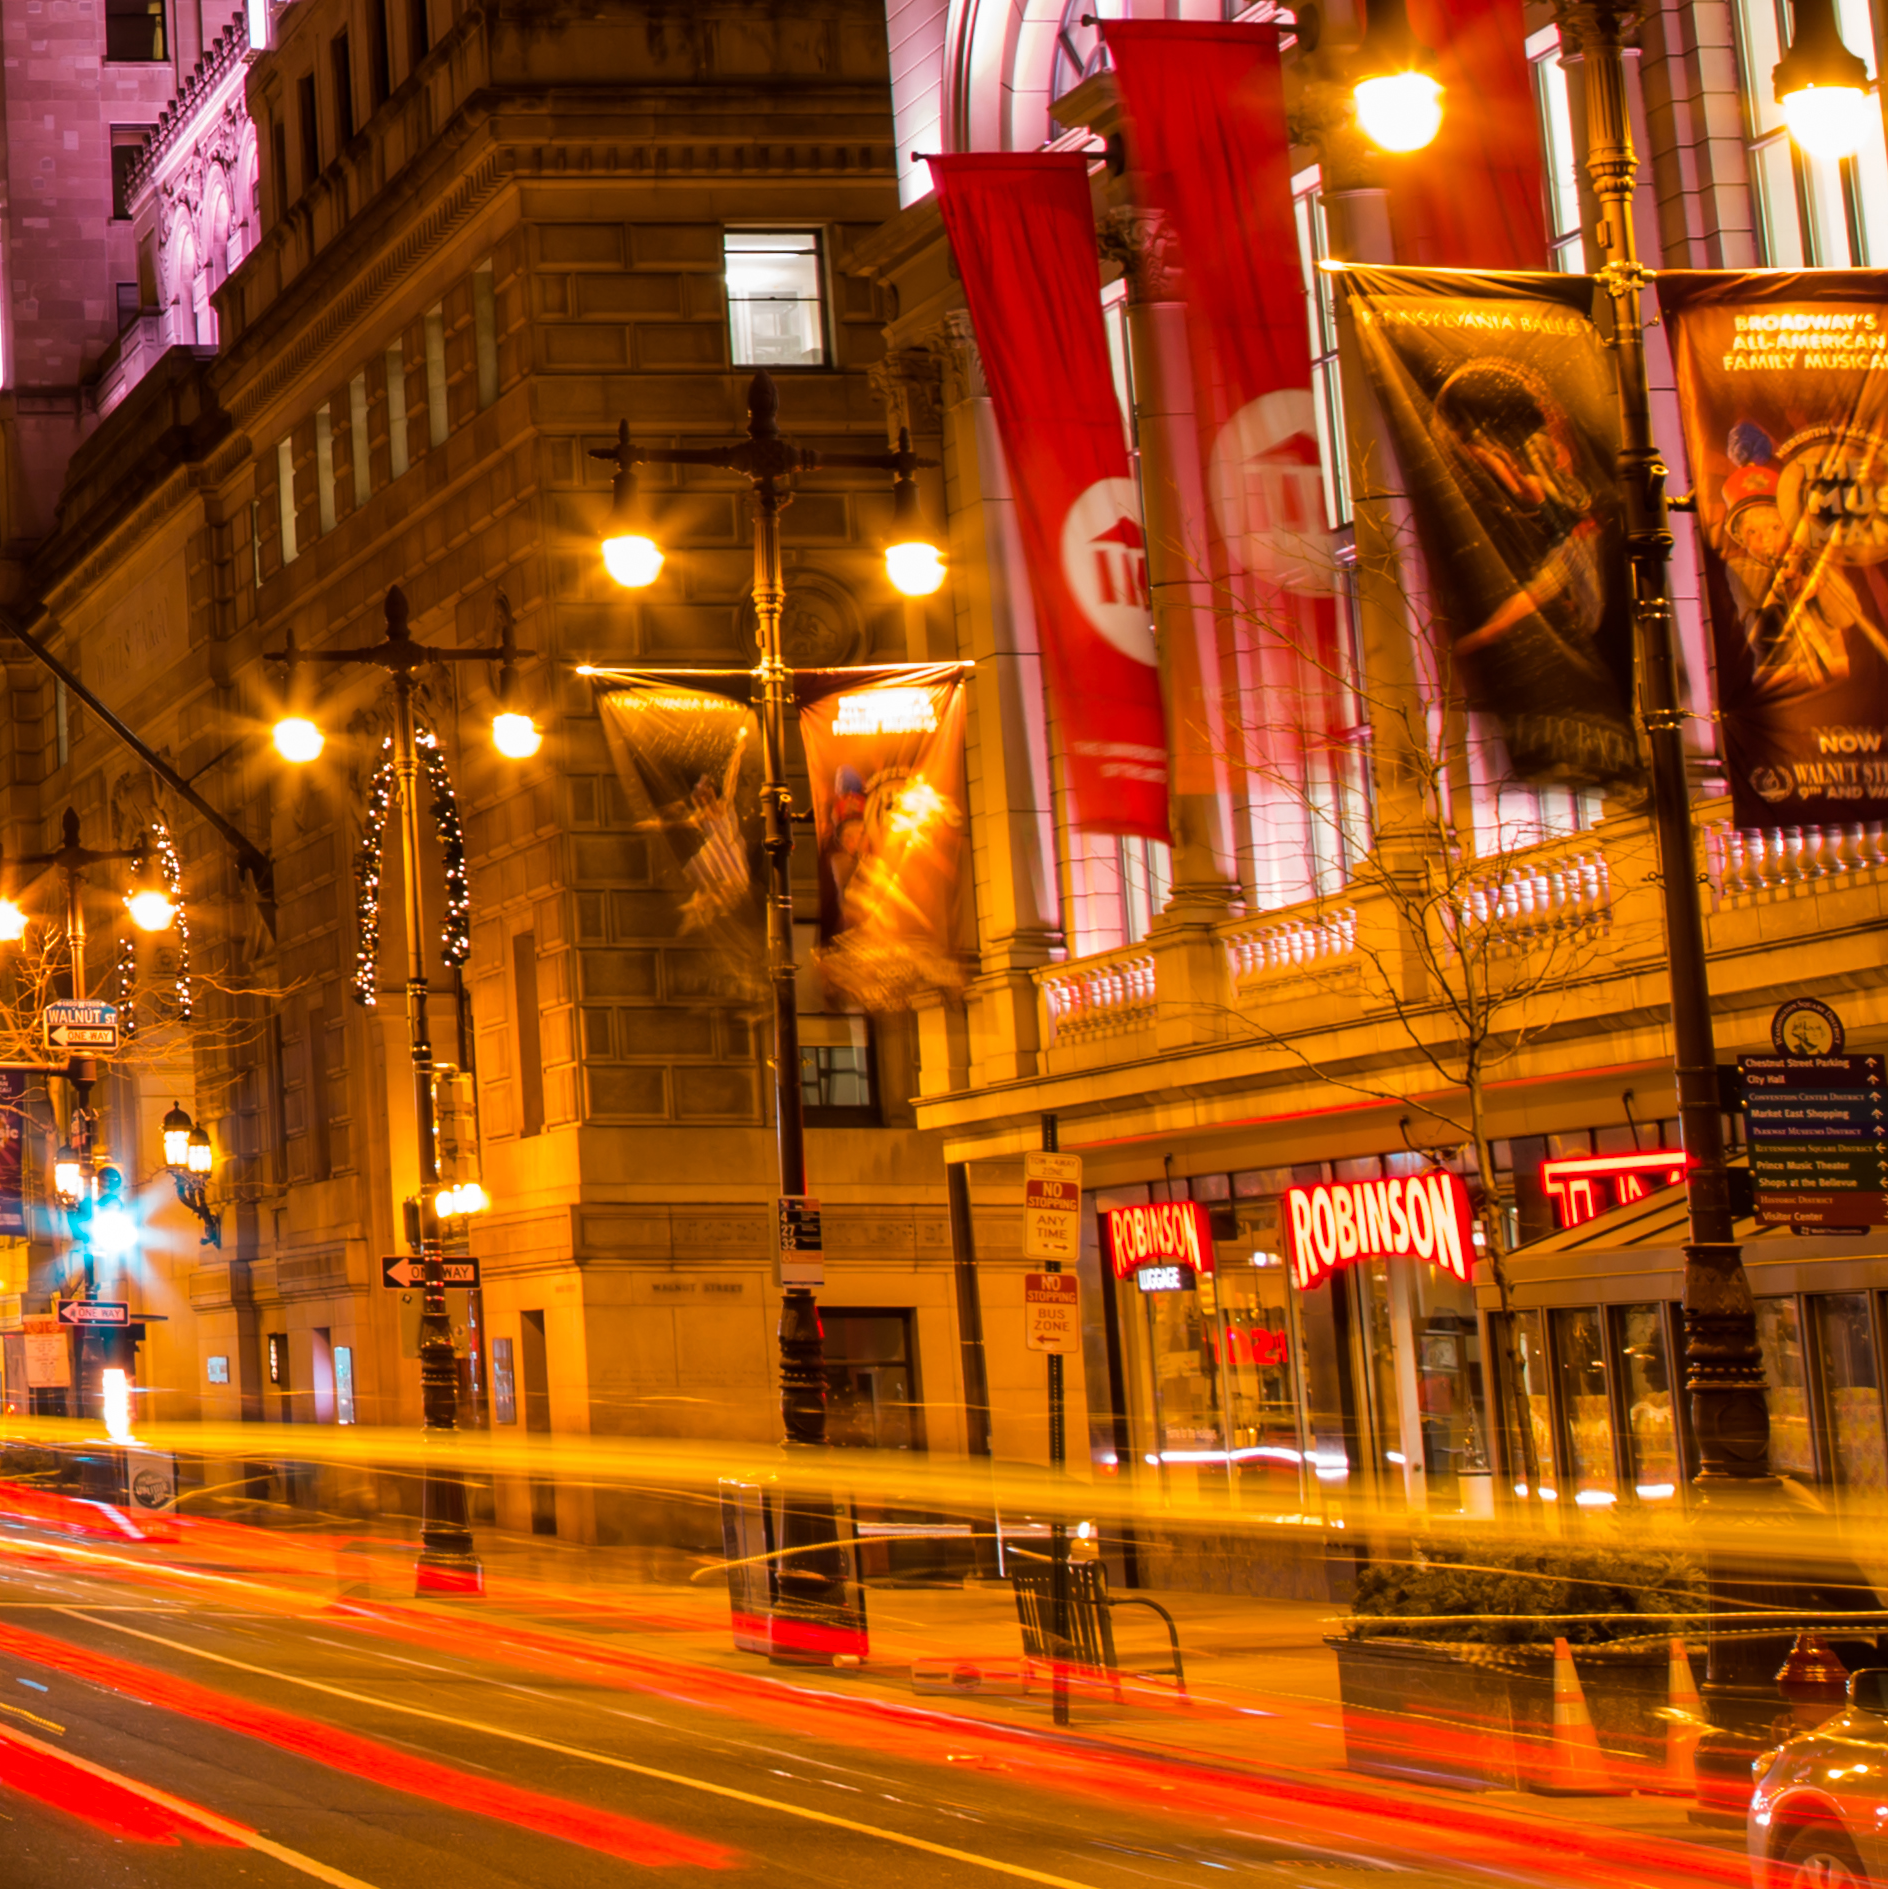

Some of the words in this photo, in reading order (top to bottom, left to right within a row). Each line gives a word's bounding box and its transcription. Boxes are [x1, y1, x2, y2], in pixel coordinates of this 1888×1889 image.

[1734, 314, 1877, 331] BROADWAY'S
[1733, 332, 1886, 350] ALL-AMERICAN
[1723, 353, 1797, 370] FAMILY
[1819, 733, 1882, 754] NOW
[48, 1010, 101, 1023] WALNUT
[105, 1013, 116, 1023] ST
[68, 1031, 86, 1041] ONE
[90, 1031, 109, 1041] WAY
[1745, 1059, 1785, 1068] Chestnut
[1787, 1058, 1814, 1068] Street
[1816, 1058, 1850, 1069] Parking
[1746, 1075, 1765, 1085] City
[1767, 1075, 1785, 1084] Hall
[1799, 1093, 1828, 1101] CENTER
[1830, 1093, 1865, 1101] DISTRICT
[1751, 1109, 1783, 1118] Market
[1785, 1109, 1804, 1118] East
[1807, 1109, 1849, 1120] Shopping
[1826, 1127, 1861, 1135] DISTRICT
[1756, 1161, 1784, 1169] Prince
[1787, 1161, 1813, 1169] Music
[1816, 1161, 1850, 1169] Theater
[1042, 1167, 1064, 1176] ZONE
[1759, 1177, 1787, 1188] Shops
[1790, 1179, 1799, 1187] at
[1801, 1178, 1816, 1187] the
[1819, 1178, 1857, 1187] Bellevue
[1043, 1182, 1063, 1197] NO
[1029, 1196, 1077, 1210] STOPPING
[1761, 1196, 1796, 1204] HISTORIC
[1798, 1196, 1833, 1204] DISTRICT
[780, 1211, 788, 1222] 4
[1037, 1215, 1067, 1226] ANY
[1762, 1212, 1791, 1221] Visitor
[1794, 1212, 1823, 1221] Center
[781, 1224, 796, 1237] 27
[1036, 1227, 1067, 1239] TIME
[1289, 1173, 1467, 1289] ROBINSON
[781, 1238, 797, 1250] 32
[1112, 1202, 1202, 1277] ROBINSON
[443, 1267, 470, 1279] WAY
[1139, 1266, 1181, 1291] LUGGAGE
[652, 1284, 697, 1292] WALNUT
[704, 1284, 744, 1293] STREET
[1041, 1275, 1062, 1291] NO
[1027, 1291, 1076, 1303] STOPPING
[78, 1308, 97, 1317] ONE
[101, 1309, 121, 1317] WAY
[1038, 1308, 1065, 1319] BUS
[1034, 1321, 1070, 1332] ZONE
